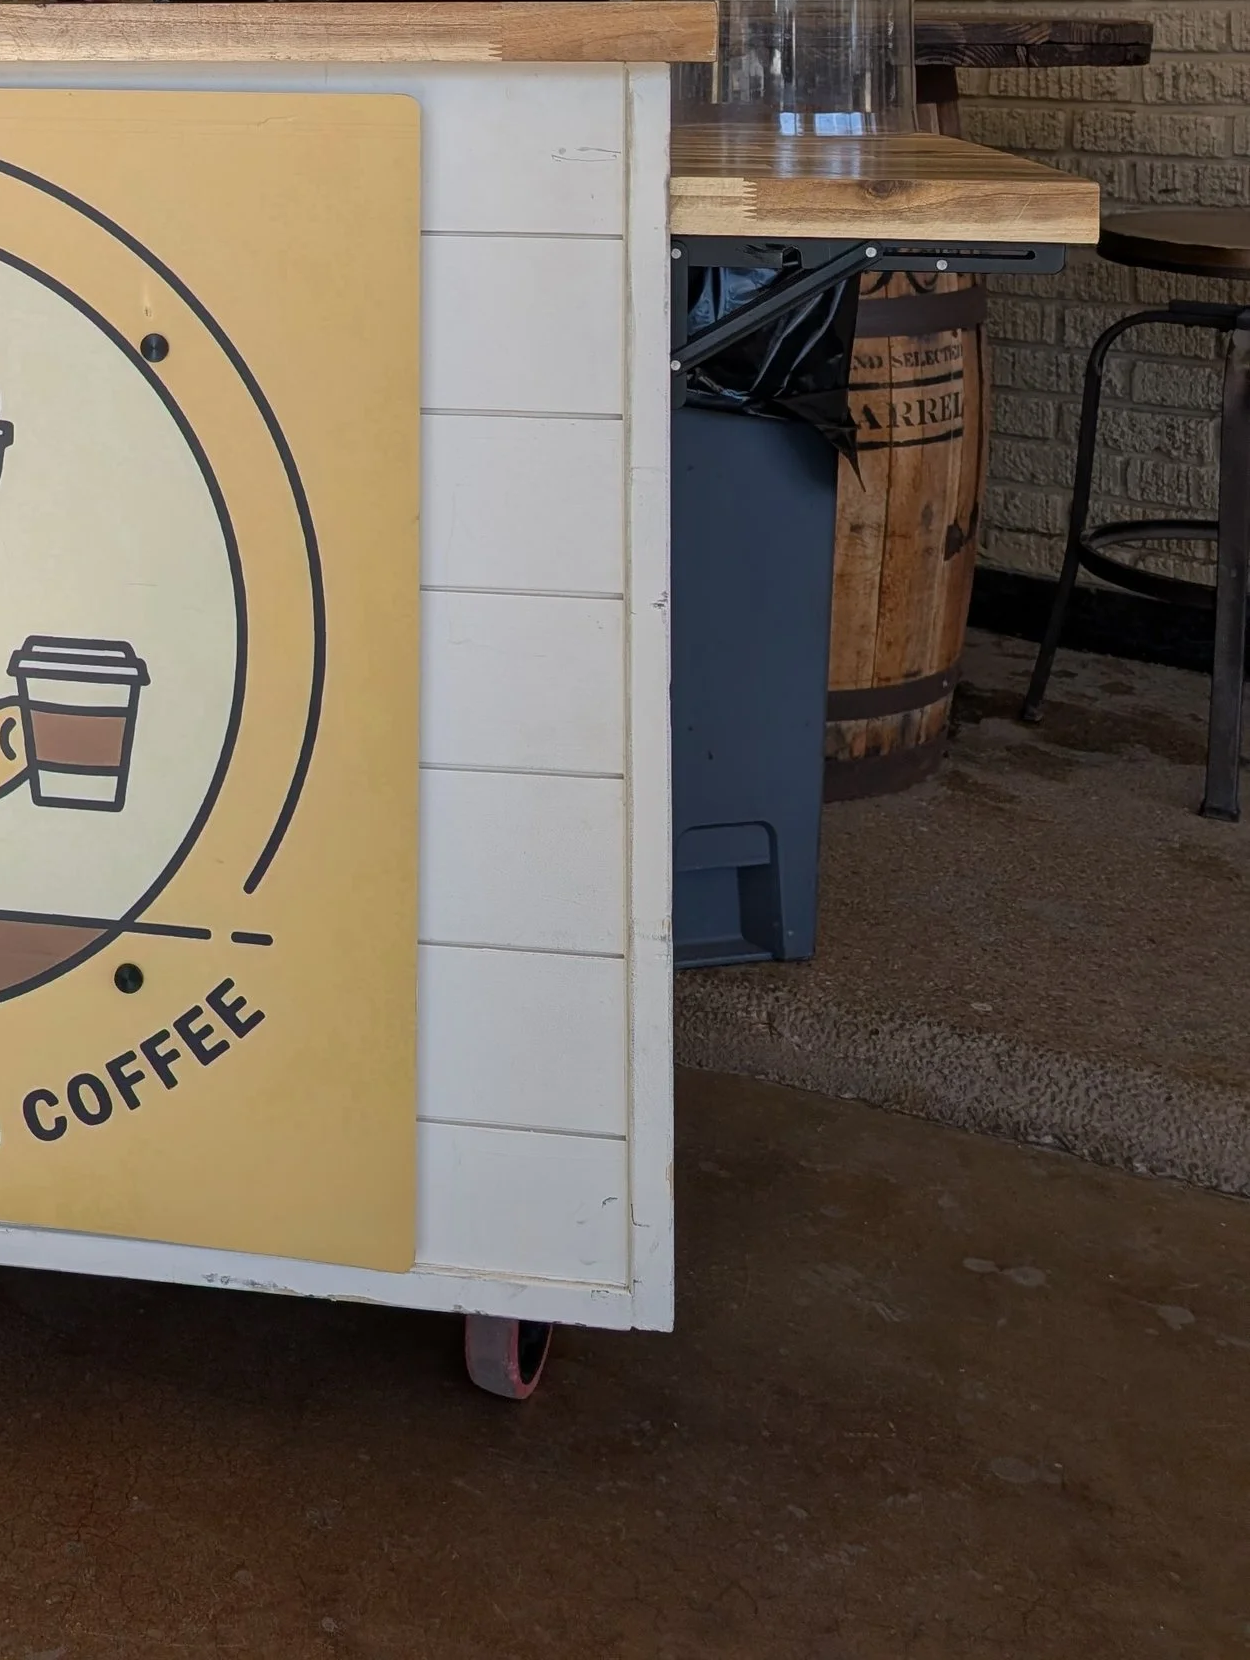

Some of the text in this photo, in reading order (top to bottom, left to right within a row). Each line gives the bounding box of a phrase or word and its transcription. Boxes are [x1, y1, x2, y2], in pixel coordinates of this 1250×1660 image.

[852, 344, 963, 370] ND SELECTE
[853, 391, 964, 430] ARREL
[22, 977, 267, 1143] COFFEE
